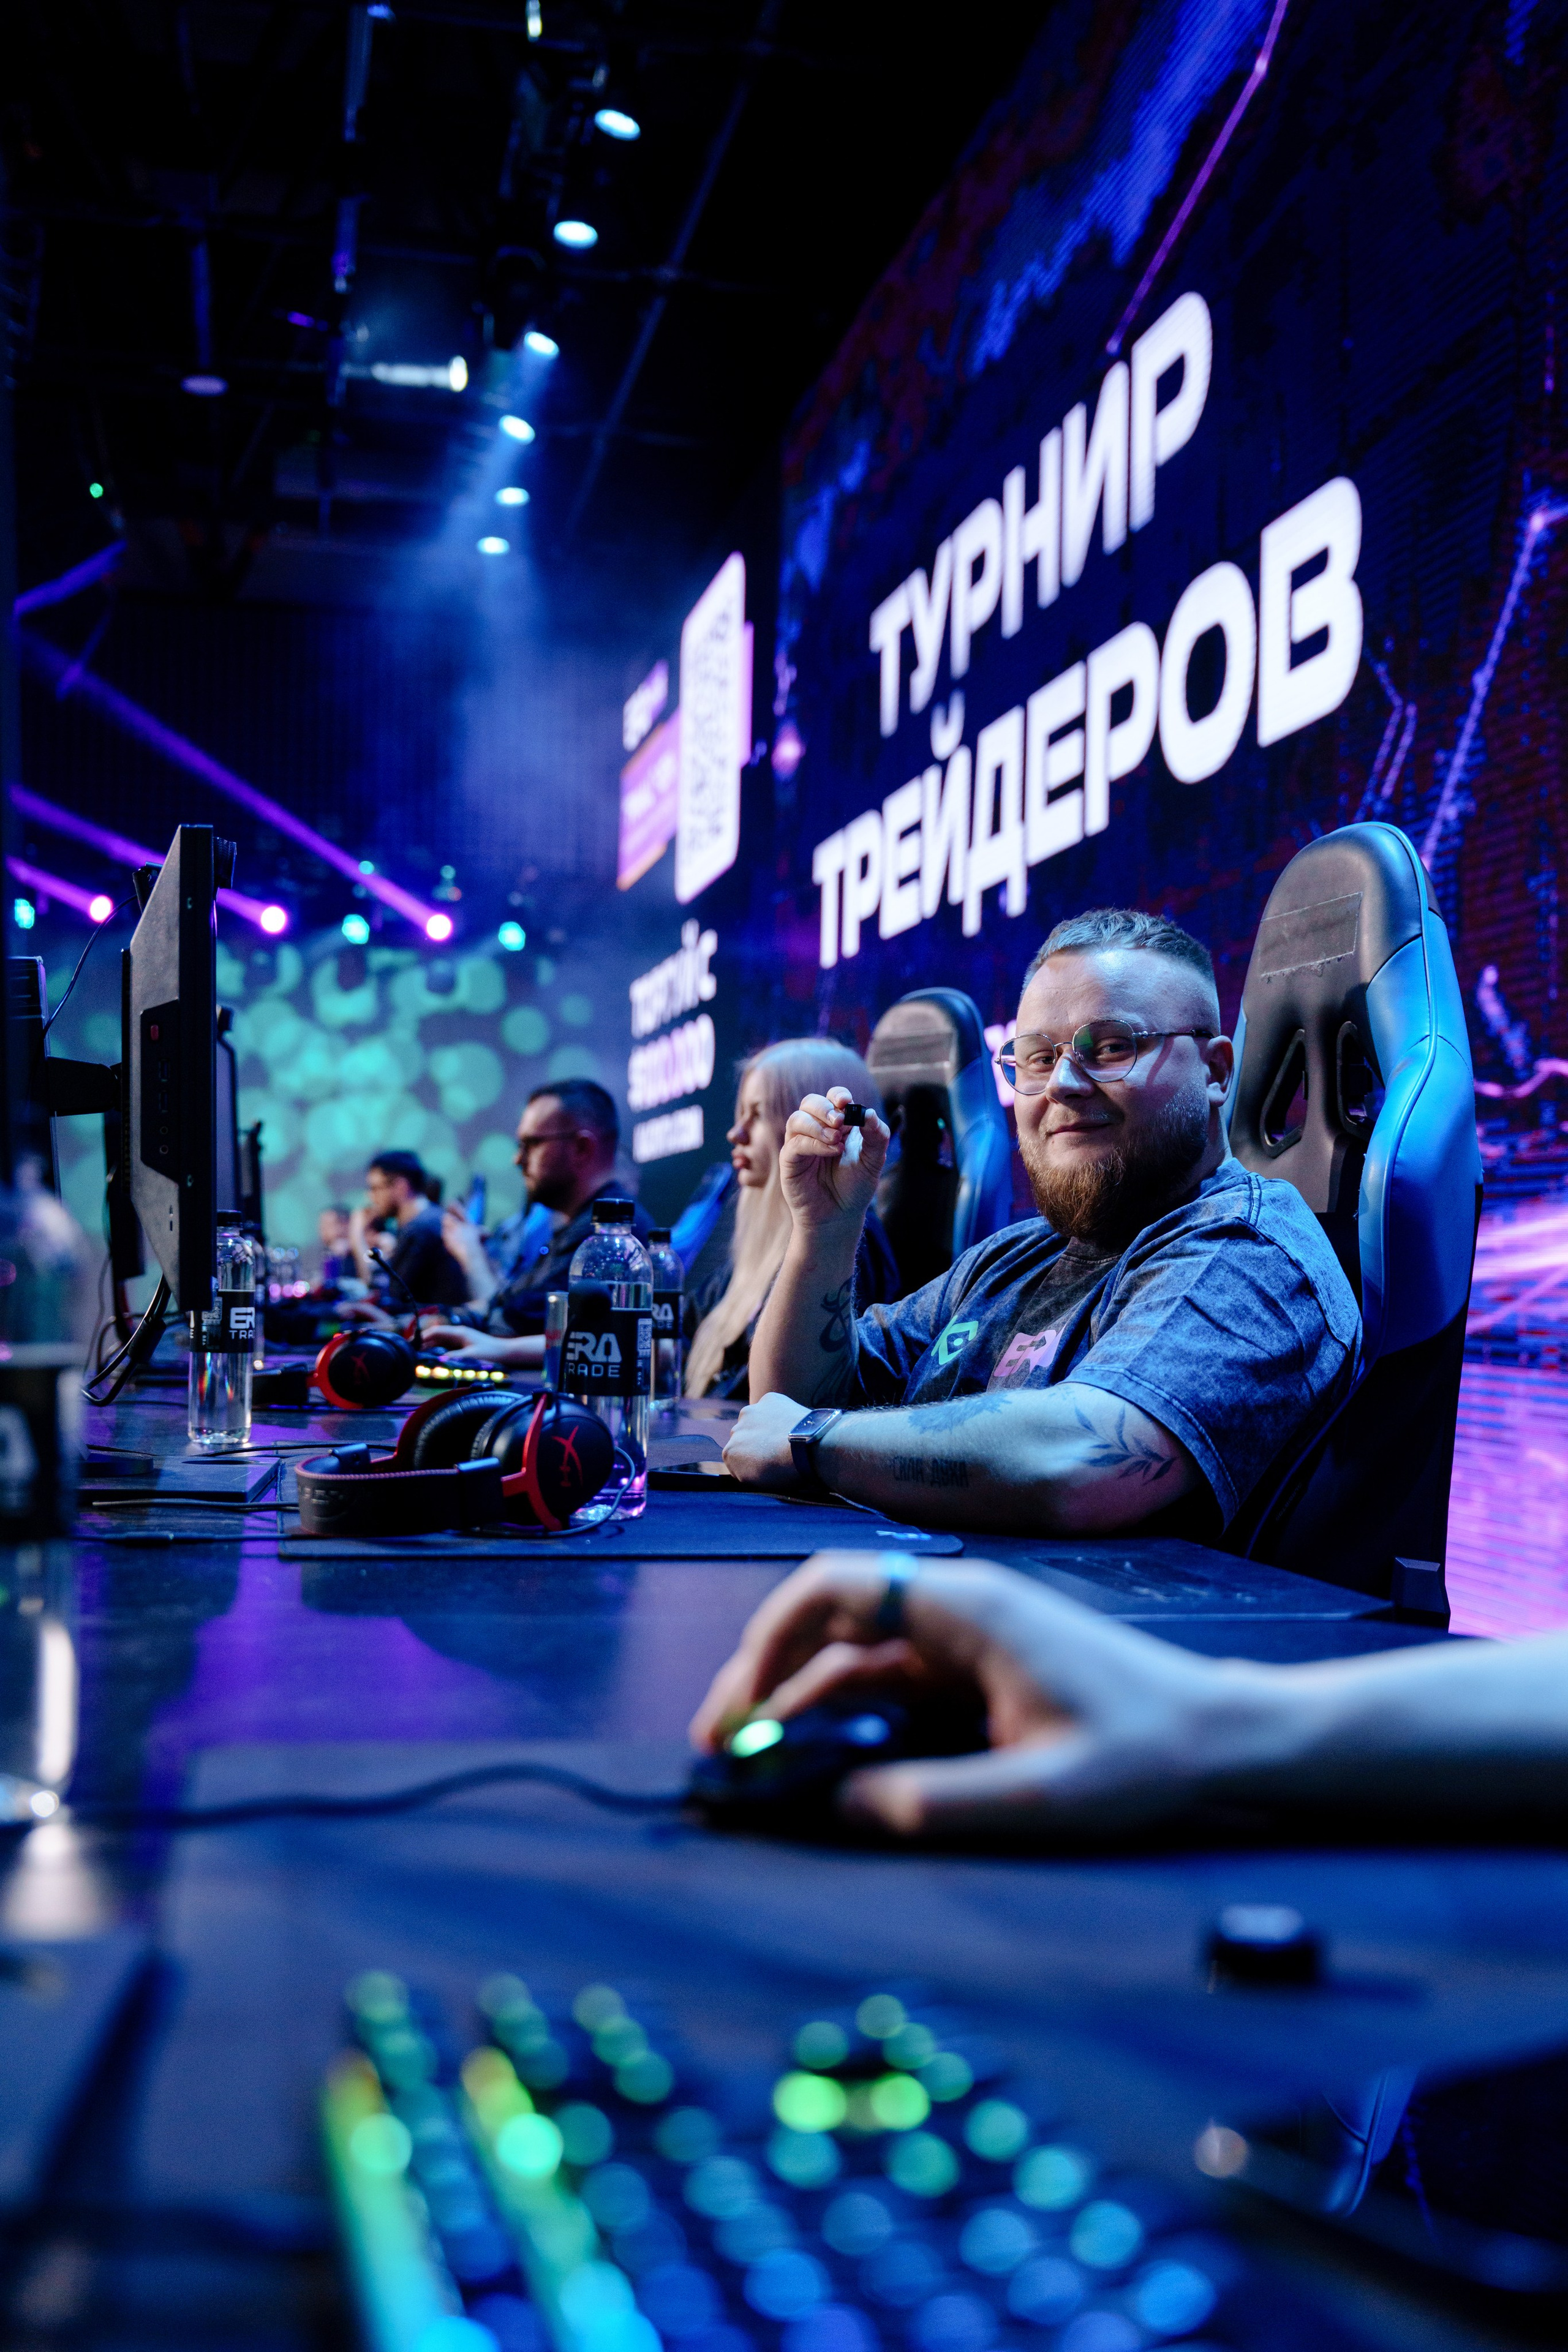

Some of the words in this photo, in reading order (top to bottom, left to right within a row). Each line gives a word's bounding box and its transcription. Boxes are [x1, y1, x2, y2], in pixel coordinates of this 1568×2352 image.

[870, 292, 1212, 737] ТУРНИР
[813, 477, 1363, 969] ТРЕЙДЕРОВ
[230, 1307, 255, 1329] ER
[229, 1330, 254, 1340] TRA
[567, 1363, 620, 1378] RADE
